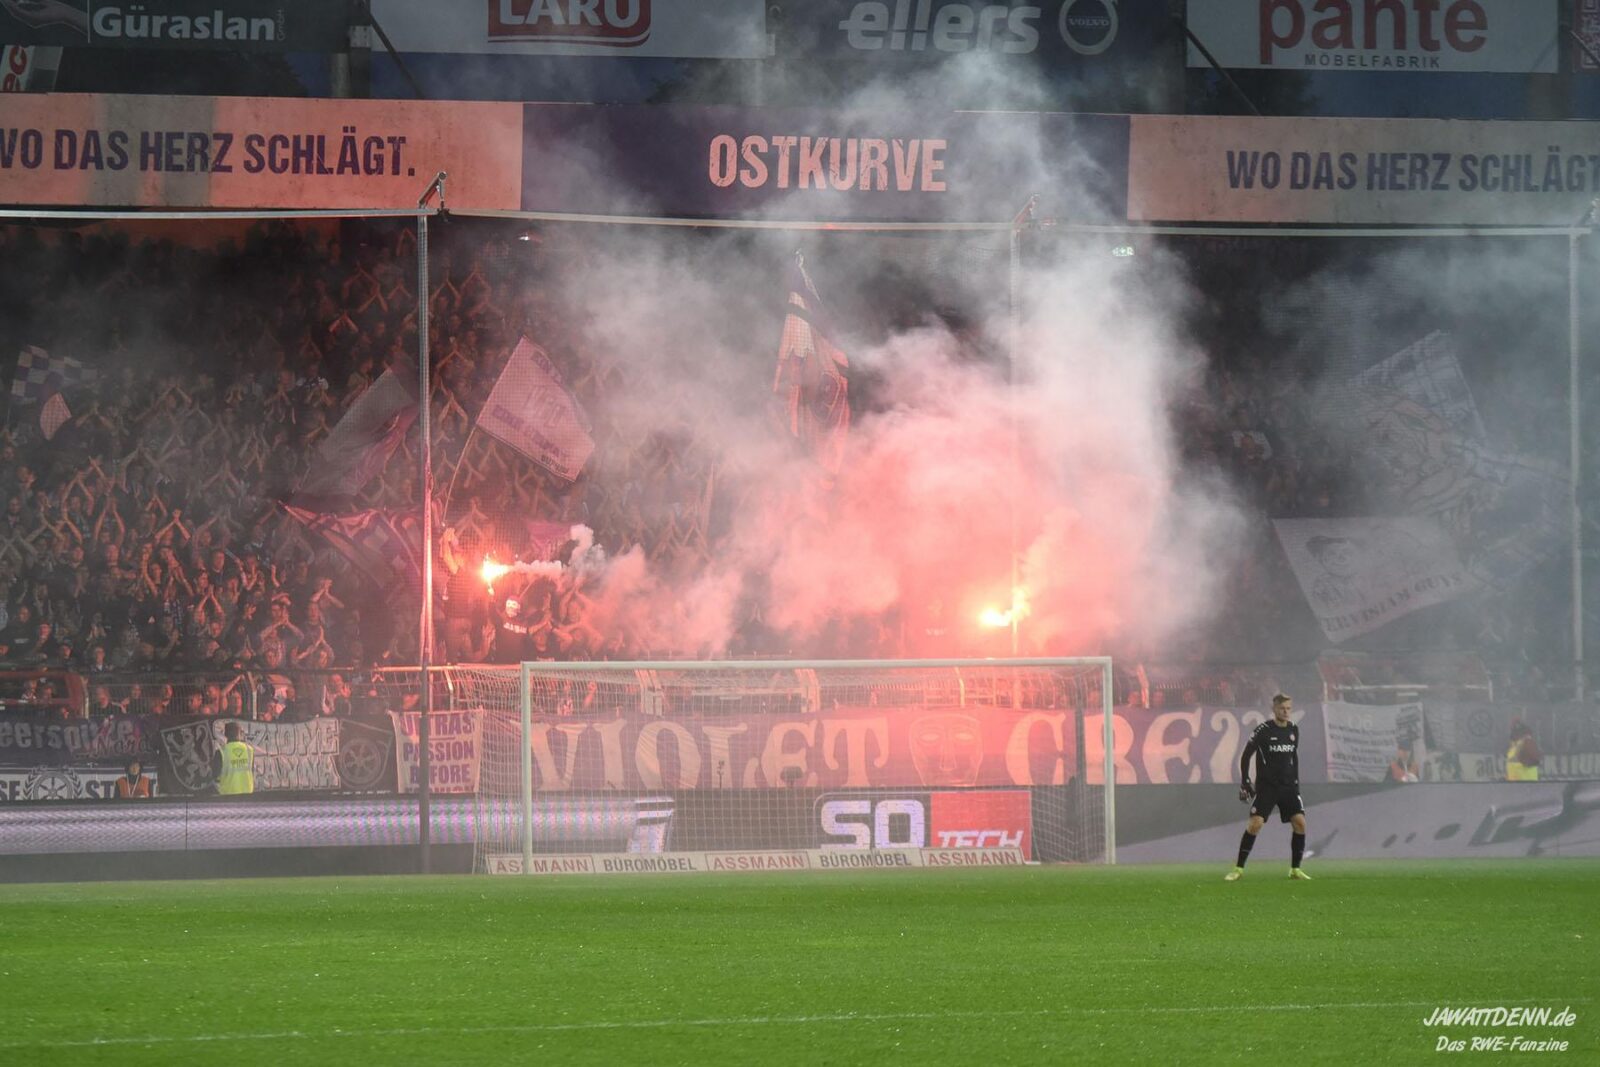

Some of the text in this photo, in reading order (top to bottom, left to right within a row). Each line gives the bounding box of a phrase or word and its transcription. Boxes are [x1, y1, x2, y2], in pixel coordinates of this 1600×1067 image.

[93, 5, 275, 40] Güraslan
[1068, 17, 1110, 27] VOLVO
[1260, 0, 1488, 65] pante
[1304, 53, 1441, 68] MÖBELFABRIK
[54, 129, 129, 171] DAS
[140, 131, 234, 173] HERZ
[243, 126, 415, 176] SCHLÄGT.
[709, 134, 947, 191] OSTKURVE
[1226, 150, 1281, 189] WO
[1289, 151, 1357, 191] DAS
[1366, 152, 1451, 191] HERZ
[510, 716, 889, 789] VIOLET
[410, 763, 470, 785] BFORE
[821, 800, 1024, 849] SO TECH
[496, 857, 589, 873] ASMANN
[604, 855, 697, 873] BÜROMÖBEL
[712, 853, 804, 870] ASSMANN
[819, 851, 912, 868] BÜROMÖBEL
[928, 850, 1018, 866] ASSMANN
